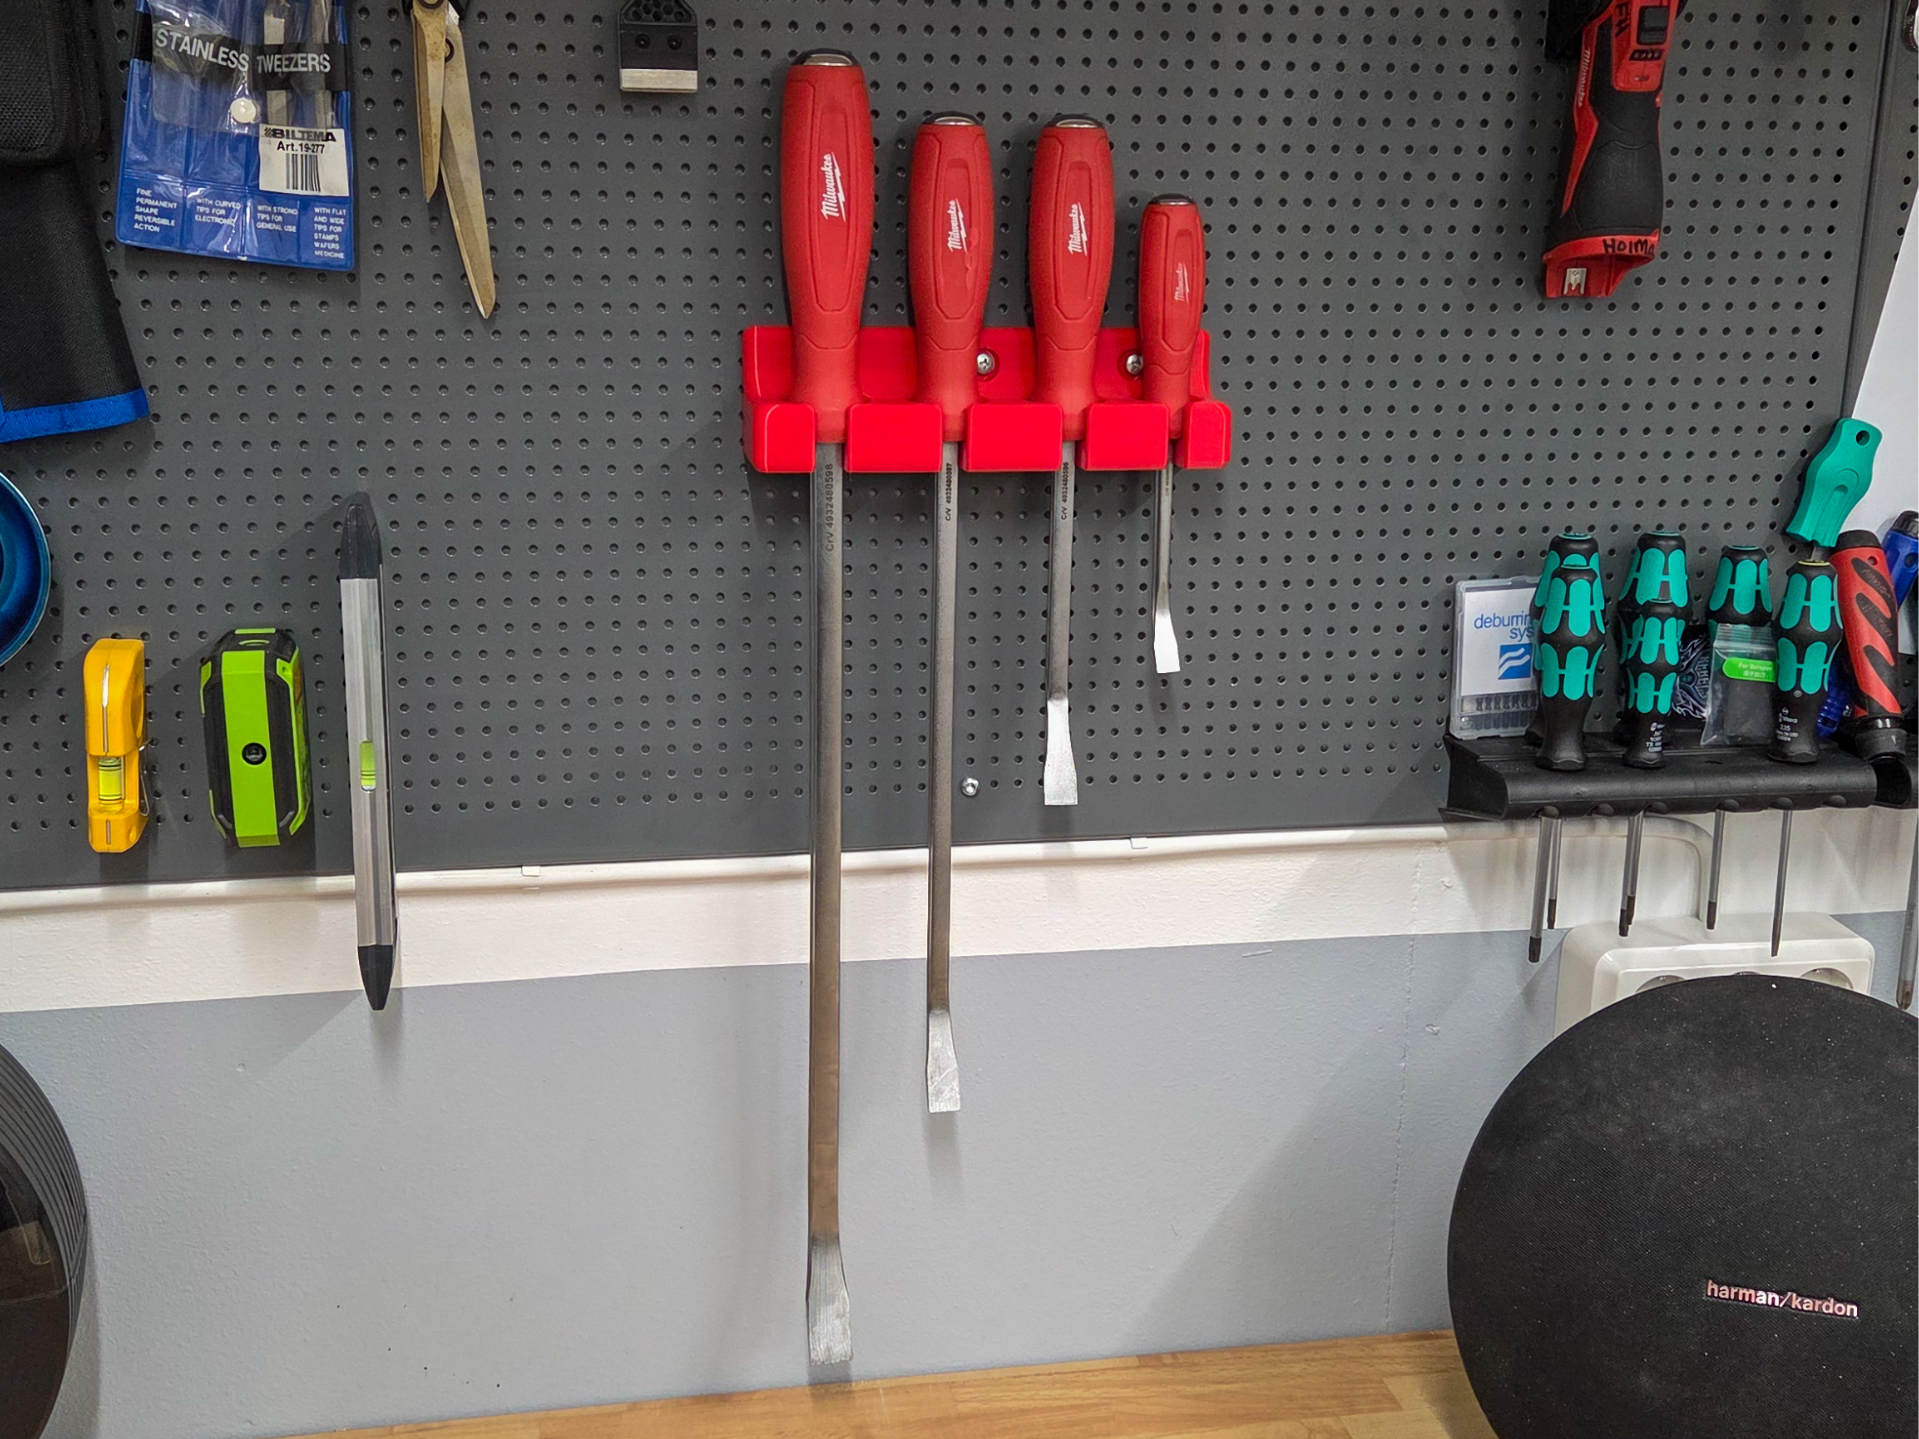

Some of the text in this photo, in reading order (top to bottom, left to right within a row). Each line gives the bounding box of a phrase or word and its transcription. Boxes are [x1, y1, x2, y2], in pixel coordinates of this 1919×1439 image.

[155, 28, 331, 73] STAINLESS TWEEZERS
[270, 128, 337, 142] BILTEMA
[821, 153, 840, 220] Milwaukee
[136, 188, 152, 197] FINE
[136, 197, 177, 209] PERMANENT
[196, 198, 241, 209] WITH CURVED
[135, 205, 158, 215] SHAPE
[196, 206, 226, 215] TIPS FOR
[257, 205, 298, 215] WITH STRONG
[332, 207, 346, 216] FLAT
[134, 214, 175, 227] REVERSIBLE
[272, 214, 283, 222] FOR
[134, 223, 160, 232] ACTION
[256, 222, 282, 231] GENERAL
[947, 200, 962, 252] Milwaukee
[1068, 203, 1082, 255] Milwaukee
[314, 233, 339, 241] STAMPS
[314, 242, 339, 250] WAFERS
[314, 250, 344, 259] MEDICINE
[825, 463, 834, 552] CrV 4932480598
[1474, 610, 1530, 629] deburrin
[1509, 627, 1534, 642] sys
[1707, 1279, 1858, 1318] harman/kardon
